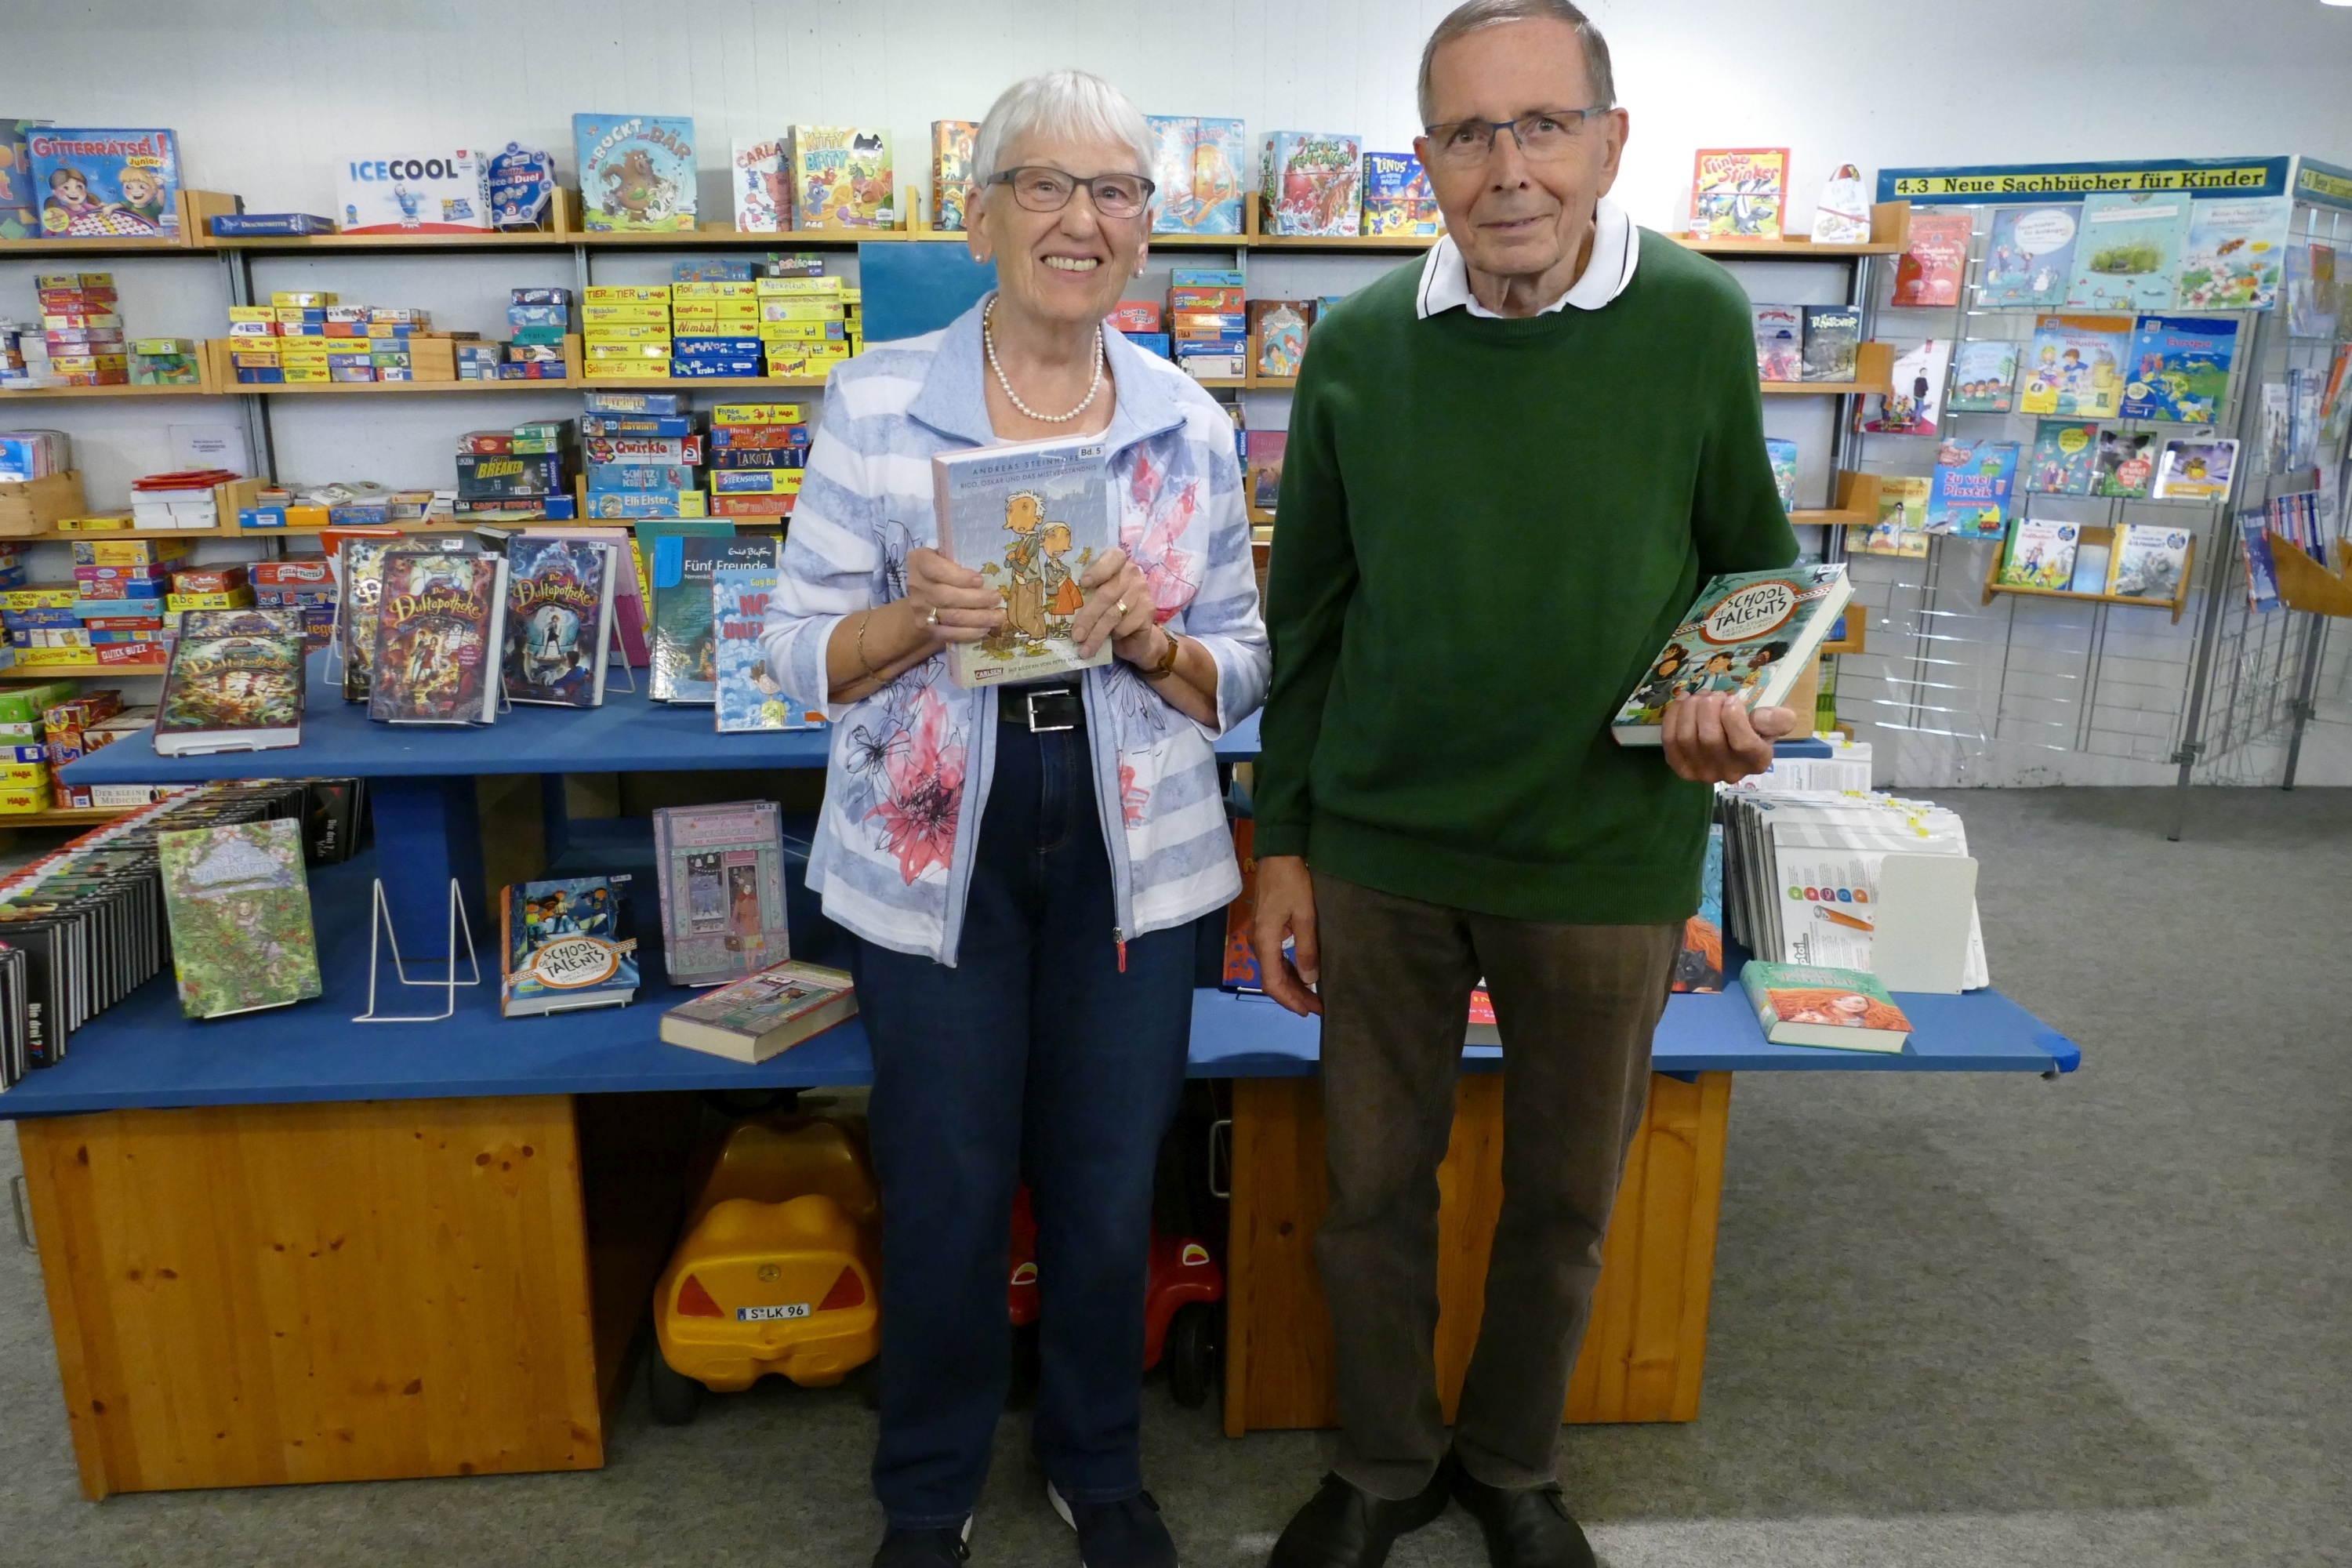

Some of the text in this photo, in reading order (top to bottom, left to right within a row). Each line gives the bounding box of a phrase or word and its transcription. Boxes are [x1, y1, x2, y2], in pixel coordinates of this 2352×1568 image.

[593, 118, 643, 160] BOCKT
[649, 127, 692, 161] BÄR
[129, 157, 160, 167] Junior
[736, 142, 785, 170] CARLA
[514, 173, 539, 183] Duel
[1718, 163, 1780, 183] Stinker
[1896, 171, 2263, 194] 4.3 Neue Sachbücher für Kinder
[586, 289, 635, 299] TIER TIER
[1131, 338, 1160, 347] ETURN
[2166, 336, 2212, 350] Europa
[596, 396, 645, 407] LABYRINTH
[604, 420, 658, 430] 3D LABYRINTH
[615, 441, 668, 455] Qwirkle
[1080, 448, 1093, 456] Bd.
[737, 452, 775, 466] LAKOTA
[476, 461, 524, 479] BREAKER
[972, 463, 1020, 476] ANDREAS
[724, 474, 770, 485] STERNSUCHER
[788, 477, 802, 485] HAB
[960, 481, 979, 490] RICO,
[981, 478, 1004, 487] OSKAR
[1037, 464, 1098, 478] MISTVERSTÄNDNIS
[1944, 472, 1991, 485] Zu viel
[1944, 485, 1992, 499] Plastik
[624, 495, 670, 506] Elli Elster
[684, 560, 768, 572] Fünf Freunde
[750, 578, 764, 587] Guy
[171, 595, 194, 605] Abc
[514, 579, 597, 610] Duftapotheke
[1727, 586, 1786, 609] SCHOOL
[392, 590, 482, 624] Duftapotheke
[1714, 597, 1788, 632] OF TALENTS
[101, 644, 147, 660] QUICK BUZZ
[975, 668, 1003, 680] CARLSEN
[95, 789, 114, 798] DER
[101, 796, 142, 804] MEDICUS
[6, 797, 31, 806] HABA
[325, 819, 337, 844] Die drei
[544, 941, 597, 960] SCHOOL
[544, 949, 605, 978] TALENTS
[28, 1003, 42, 1018] Die
[29, 1020, 42, 1038] drei
[751, 1305, 804, 1319] S LK 96
